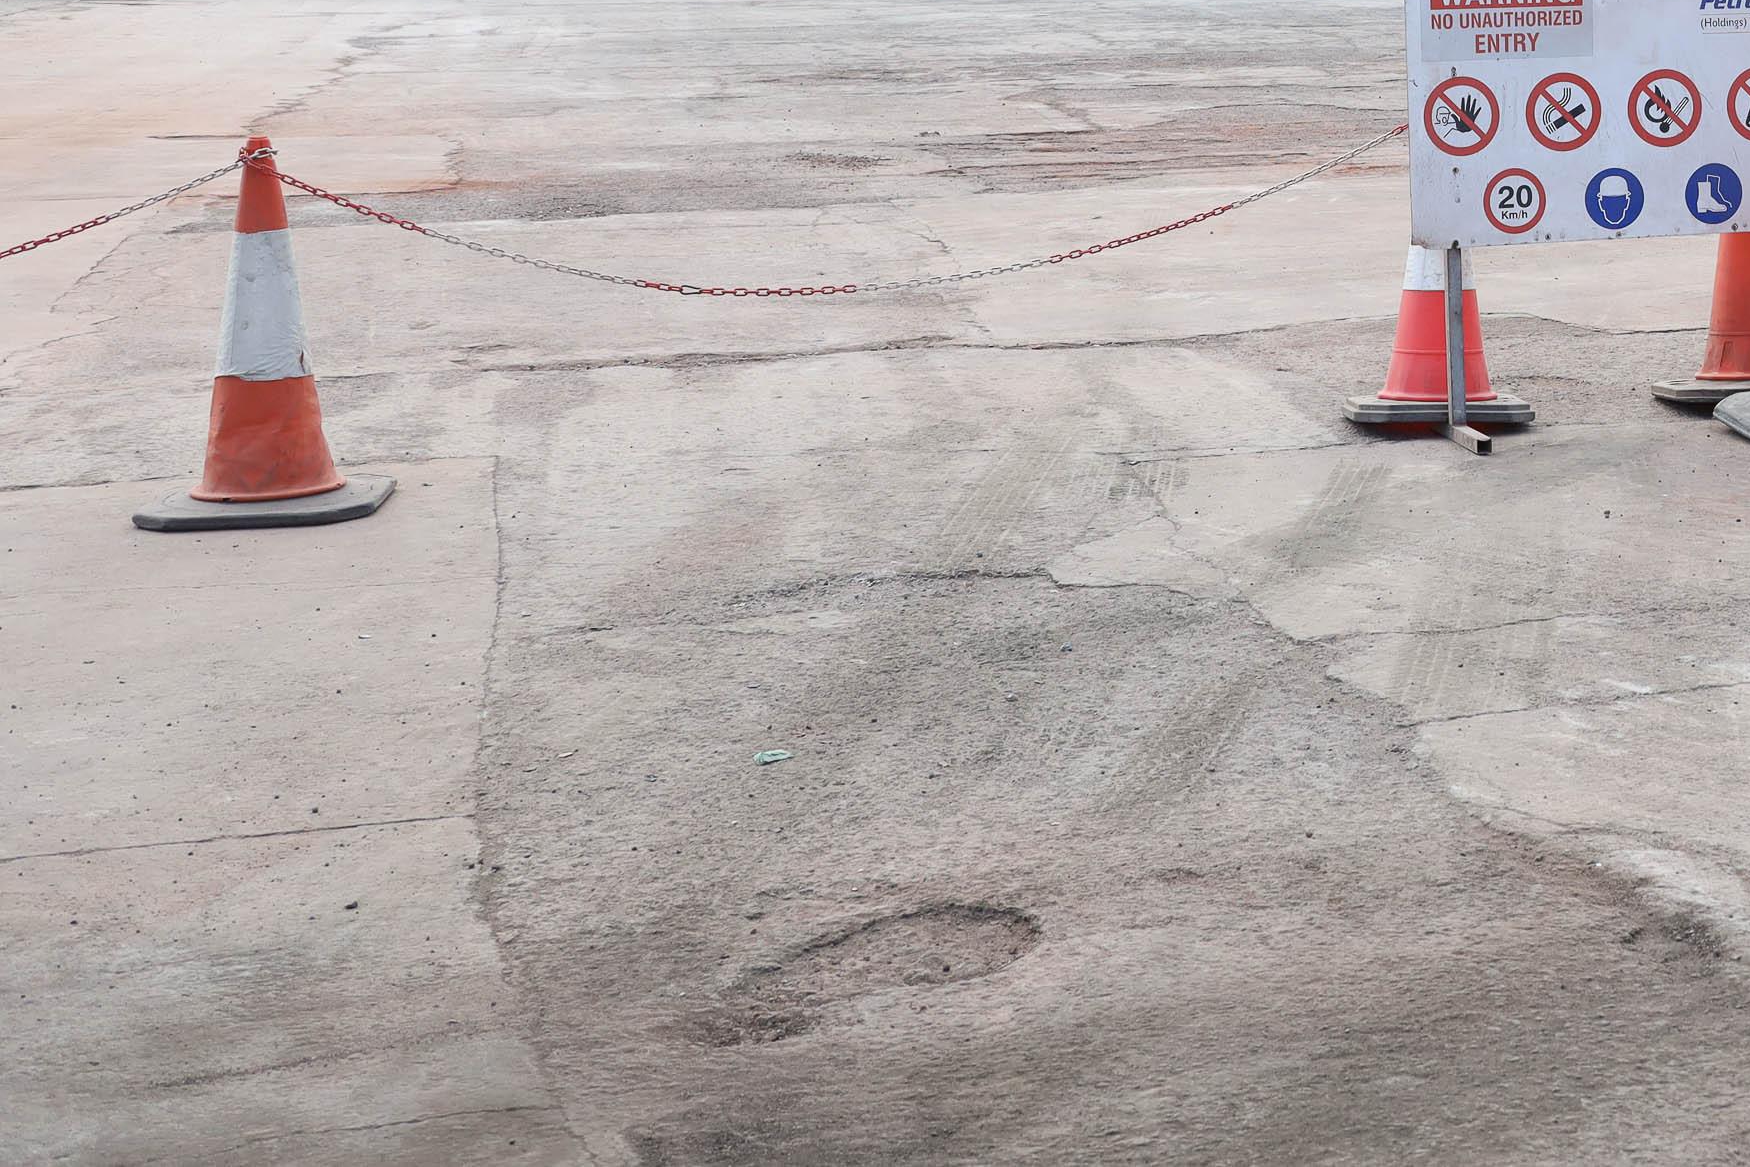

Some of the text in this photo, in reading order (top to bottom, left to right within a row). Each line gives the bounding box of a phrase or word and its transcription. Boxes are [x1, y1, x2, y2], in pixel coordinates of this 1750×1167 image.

[1431, 10, 1583, 30] NO UNAUTHORIZED
[1700, 17, 1747, 30] (Holdings)
[1475, 32, 1540, 54] ENTRY
[1498, 184, 1533, 209] 20
[1501, 210, 1528, 220] Km/h
